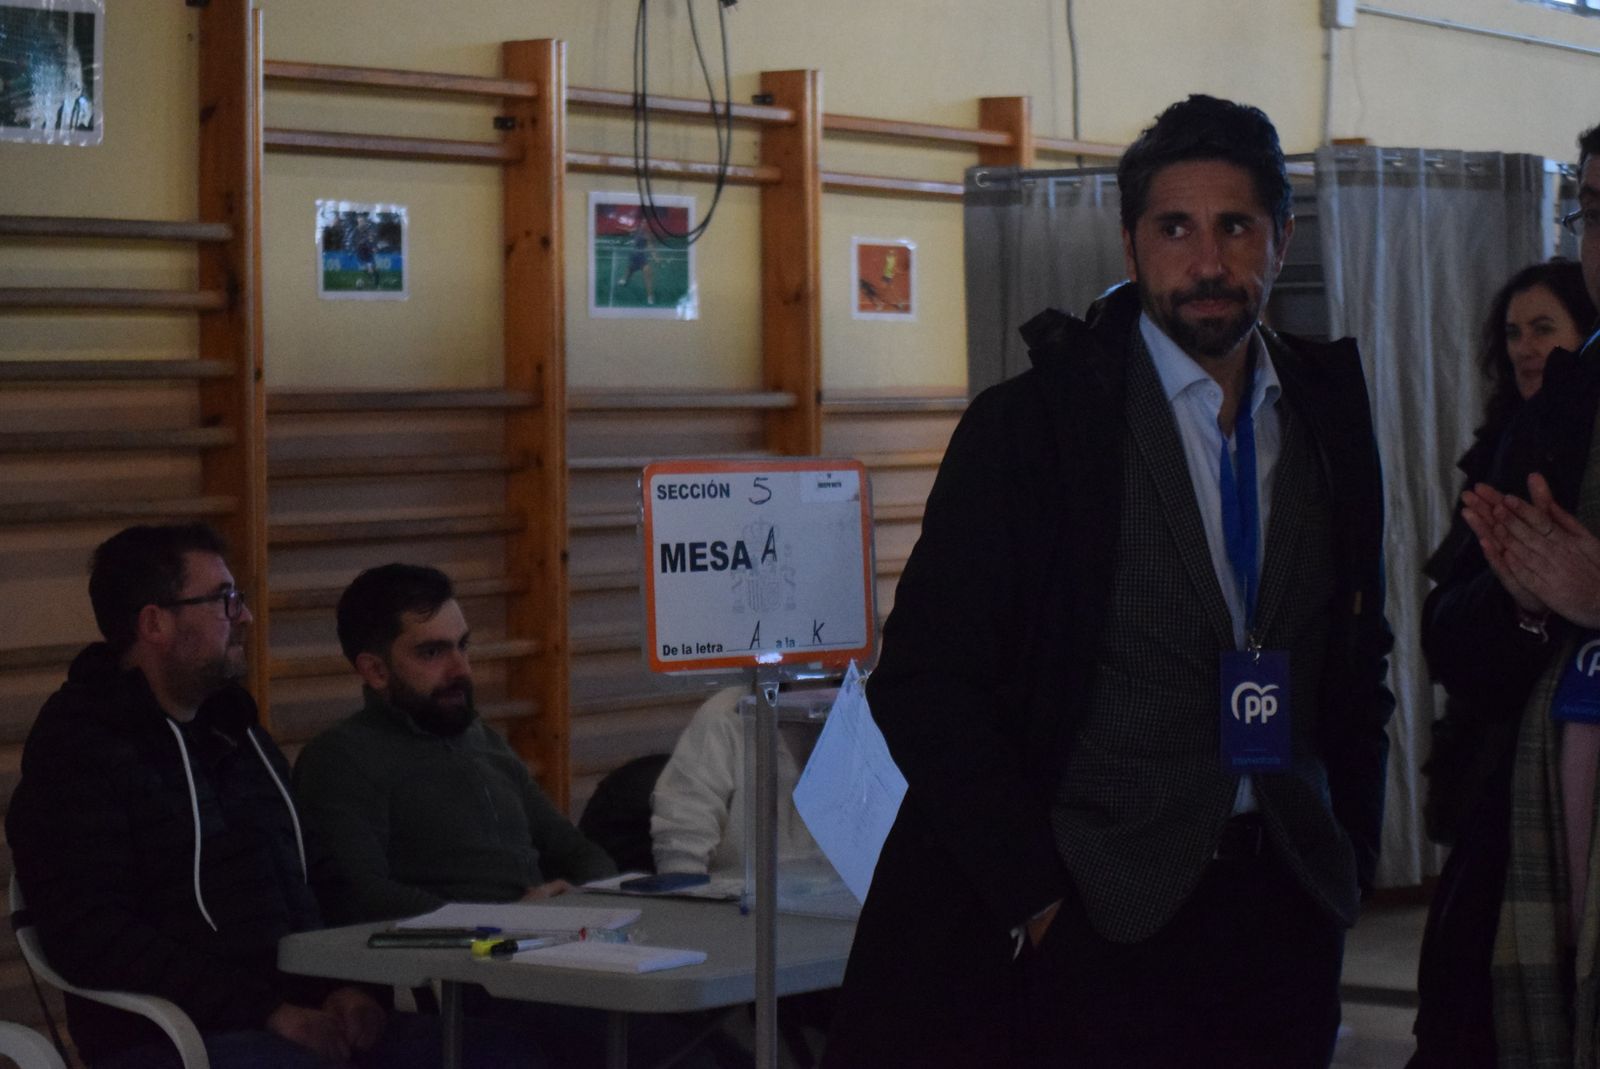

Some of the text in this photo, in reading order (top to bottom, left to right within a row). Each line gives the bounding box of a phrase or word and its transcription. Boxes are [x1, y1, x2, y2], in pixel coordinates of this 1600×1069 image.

[657, 477, 772, 505] SECCIÓN 5
[660, 526, 777, 574] MESA A
[662, 619, 825, 656] De la letra A a la K
